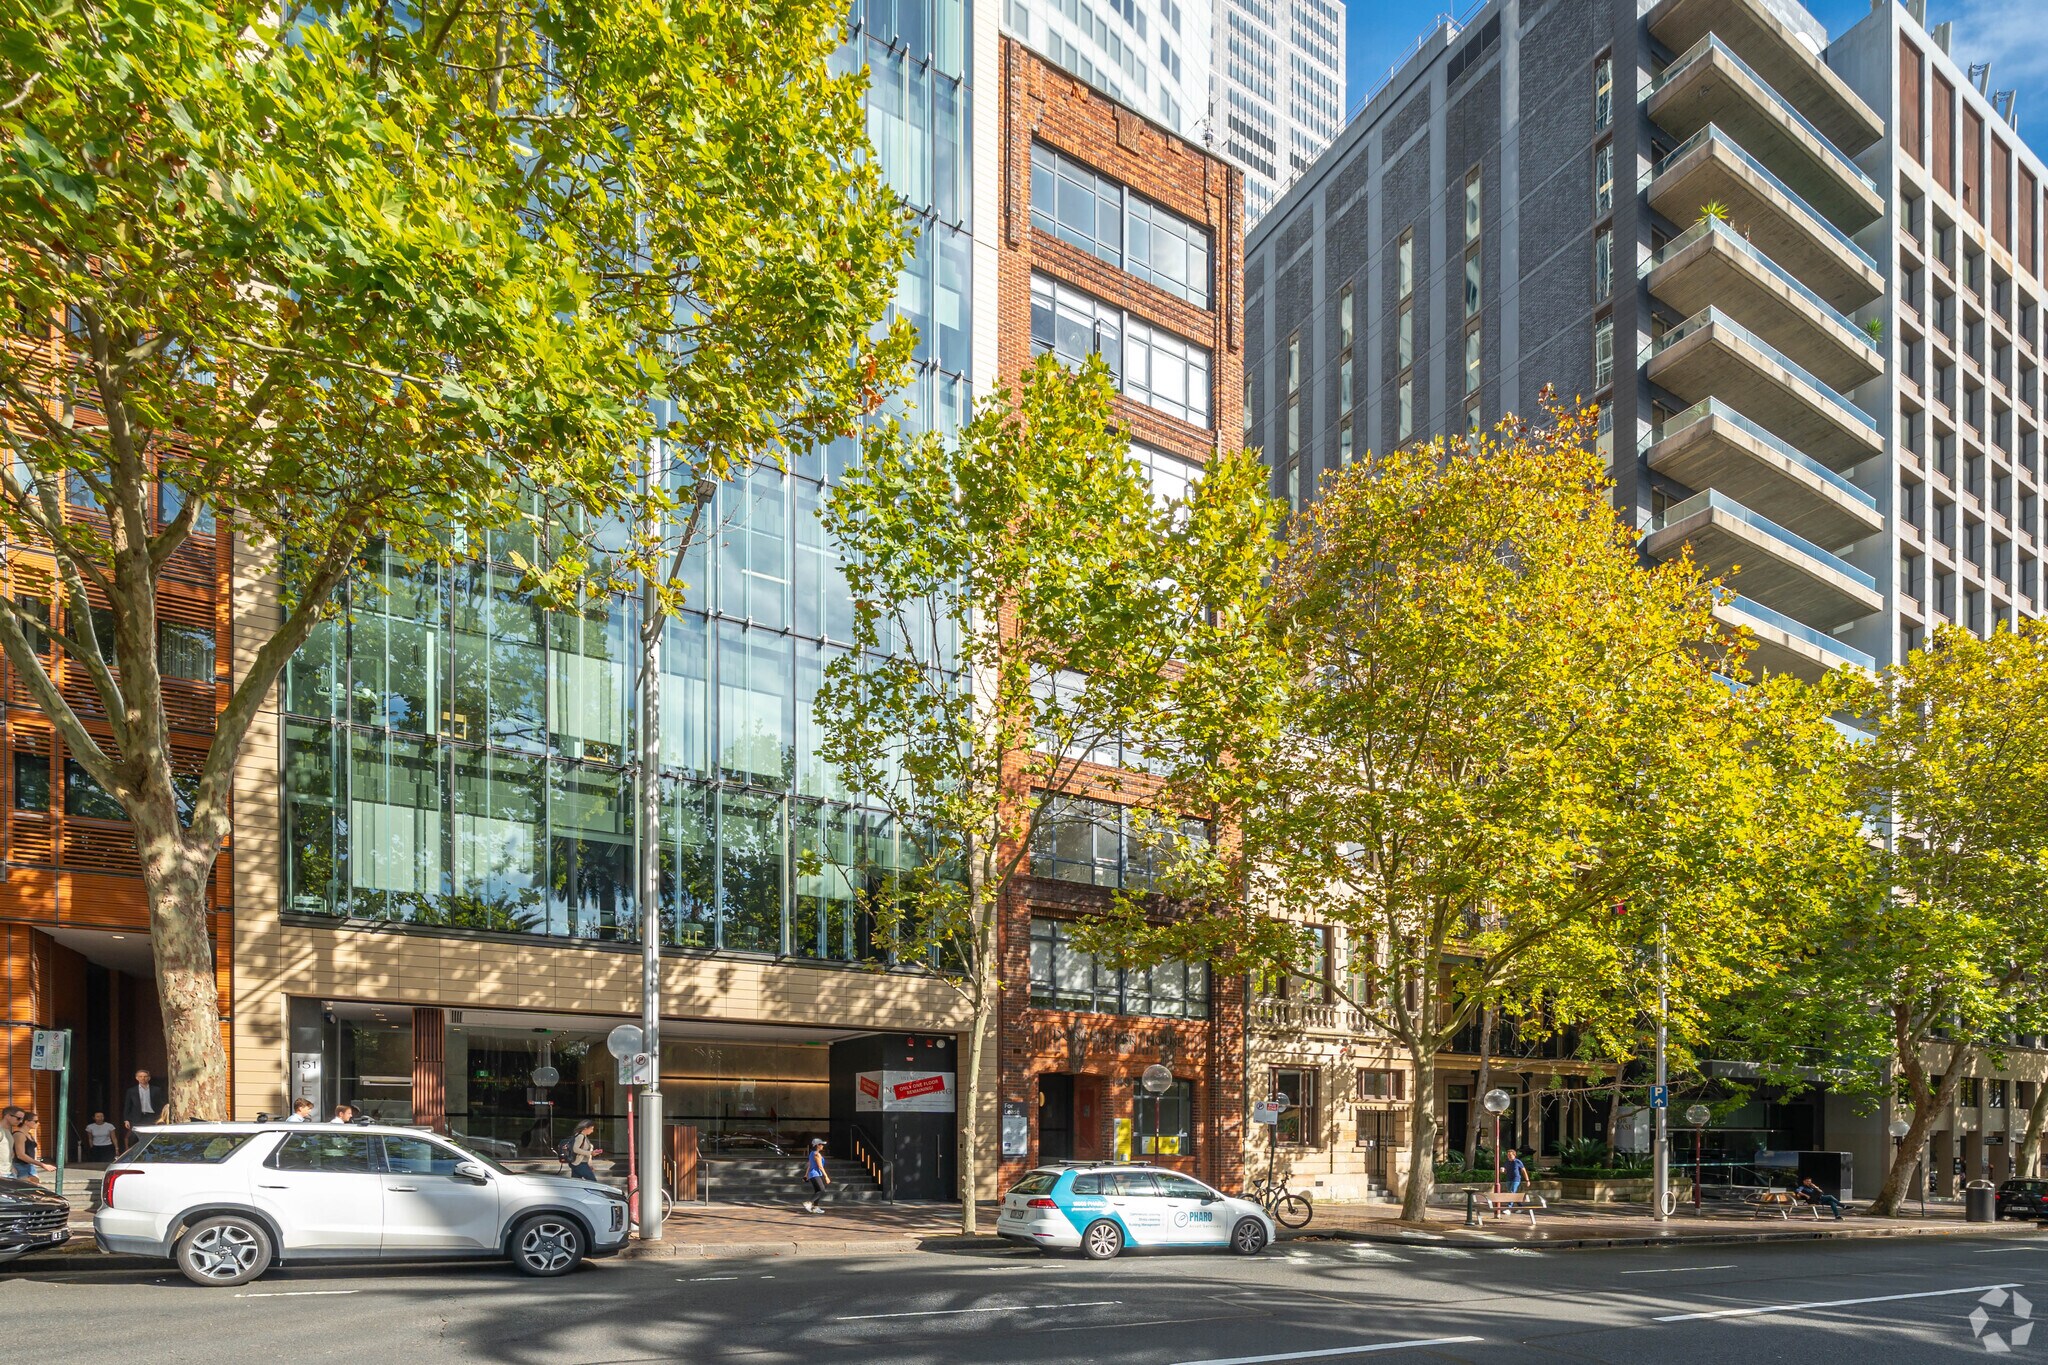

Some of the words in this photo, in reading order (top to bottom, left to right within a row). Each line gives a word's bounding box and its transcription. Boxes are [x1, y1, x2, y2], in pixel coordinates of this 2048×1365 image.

[296, 1060, 317, 1069] 151
[924, 1079, 939, 1087] FLOOR
[1655, 1087, 1663, 1097] P
[1189, 1211, 1213, 1222] PHARO
